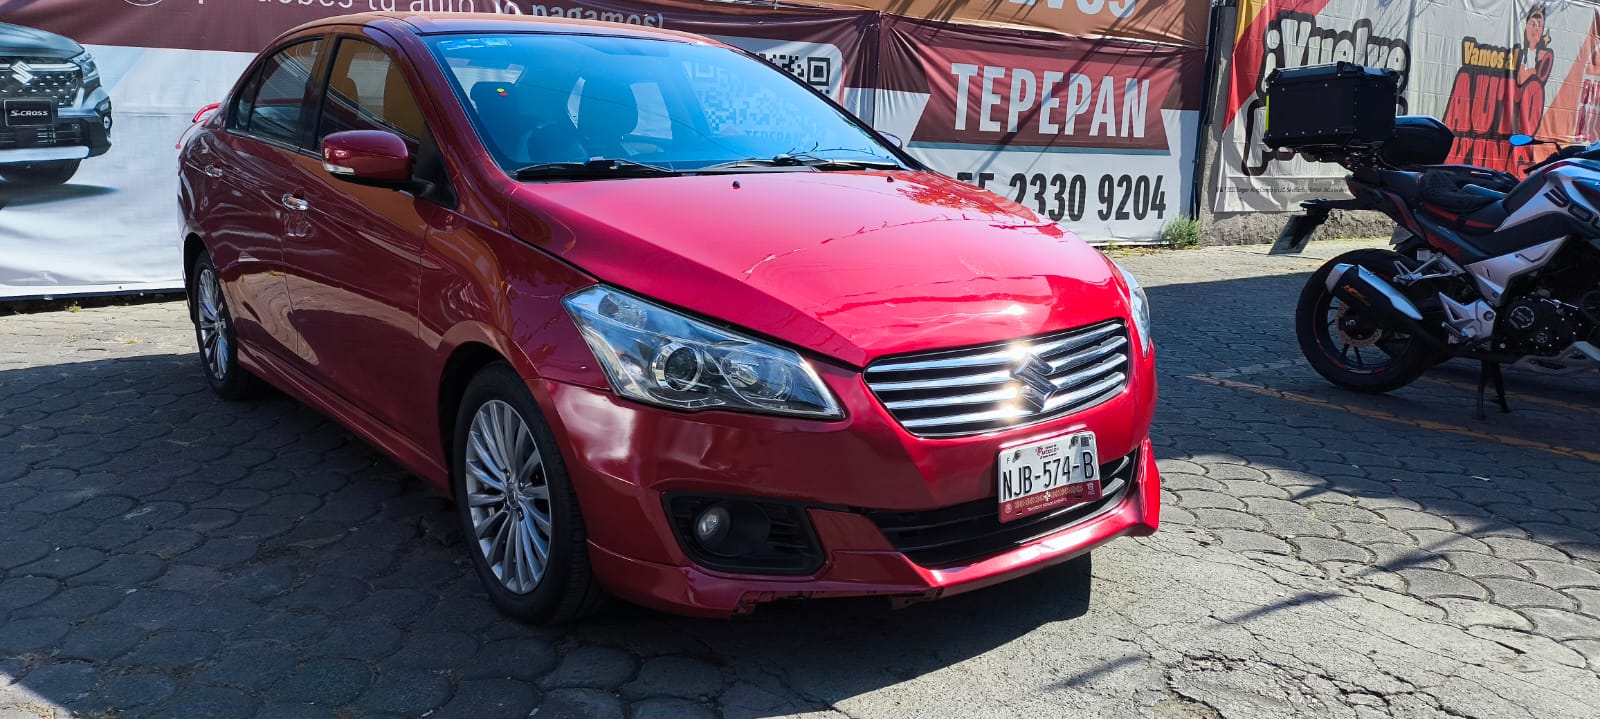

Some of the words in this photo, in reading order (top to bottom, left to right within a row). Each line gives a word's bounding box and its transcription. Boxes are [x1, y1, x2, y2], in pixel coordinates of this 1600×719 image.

[1464, 41, 1505, 69] Vamos
[951, 63, 1149, 138] TEPEPAN
[1444, 73, 1543, 135] AUTO
[1009, 172, 1087, 222] 2330
[1097, 173, 1166, 221] 9204
[1002, 451, 1095, 501] NJB-574-B
